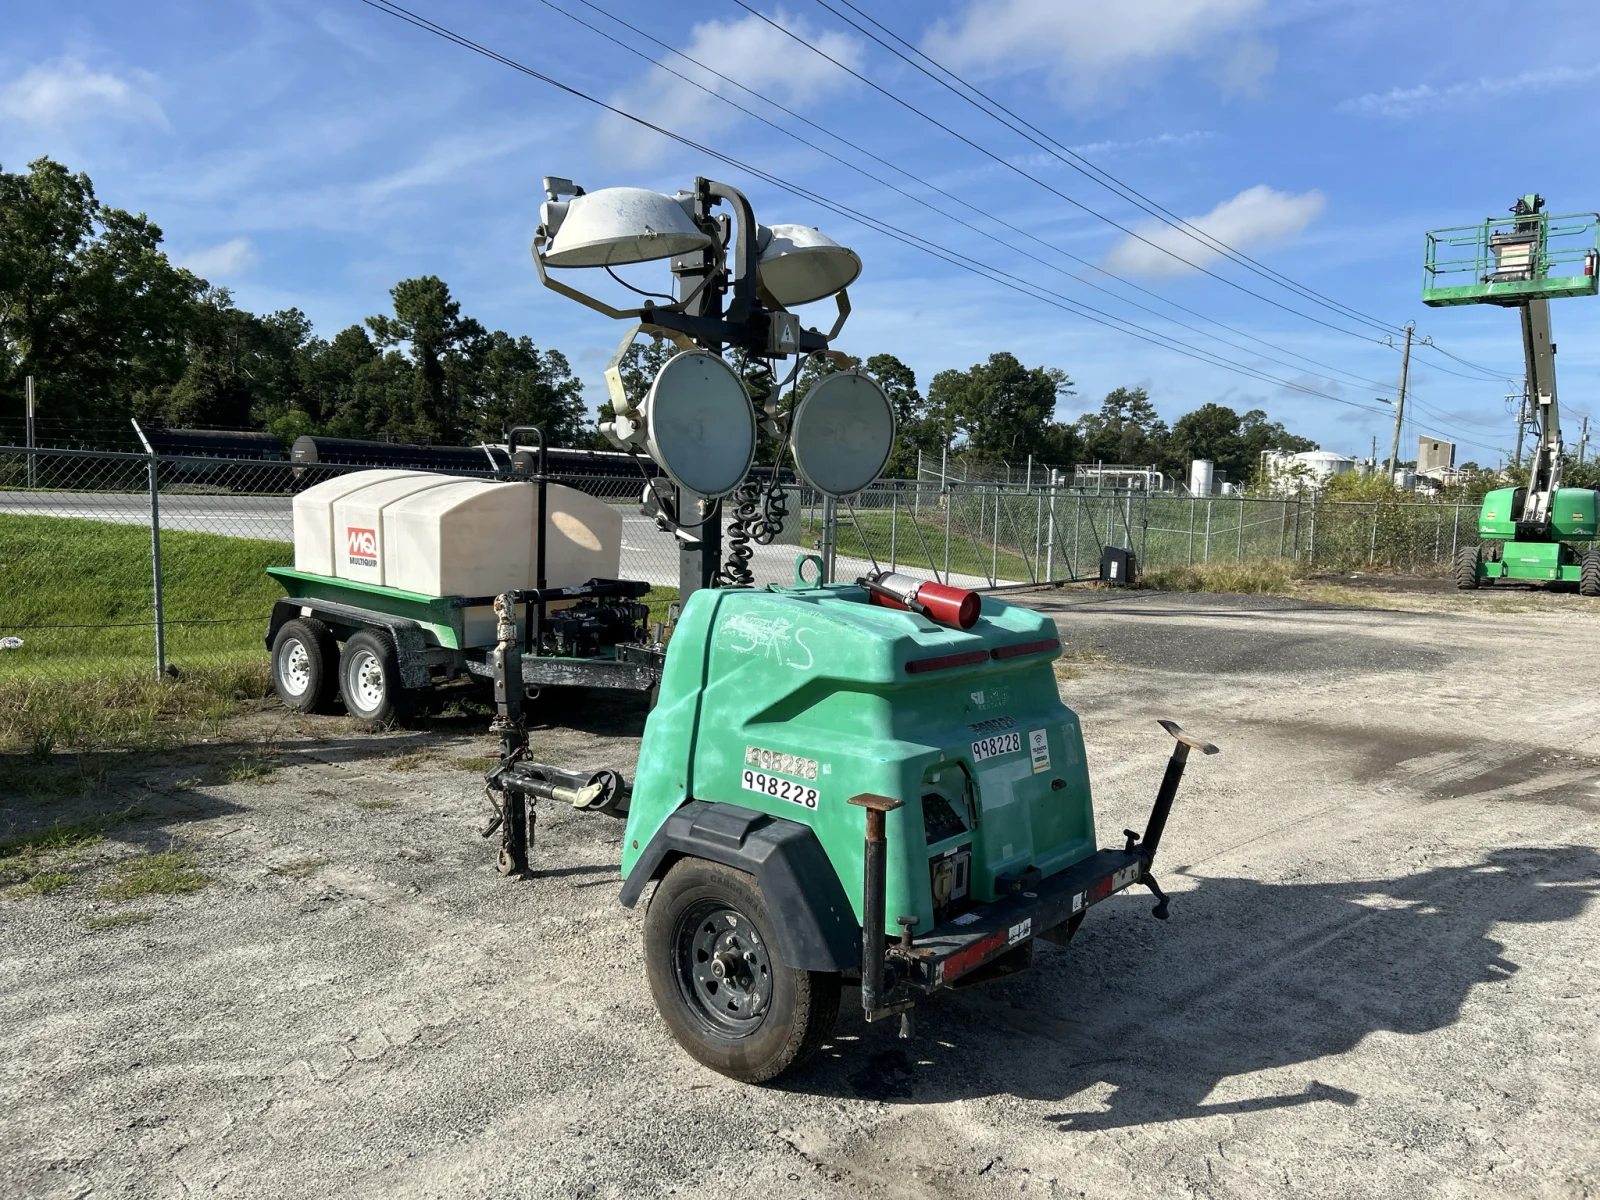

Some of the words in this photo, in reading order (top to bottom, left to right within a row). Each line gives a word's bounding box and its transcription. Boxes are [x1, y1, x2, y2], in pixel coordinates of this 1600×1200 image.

[349, 531, 377, 555] MQ
[349, 557, 377, 567] MULTIQUIP
[973, 734, 1019, 759] 998228
[744, 771, 817, 808] 998228
[710, 874, 743, 896] CARGO
[745, 894, 765, 918] MAX
